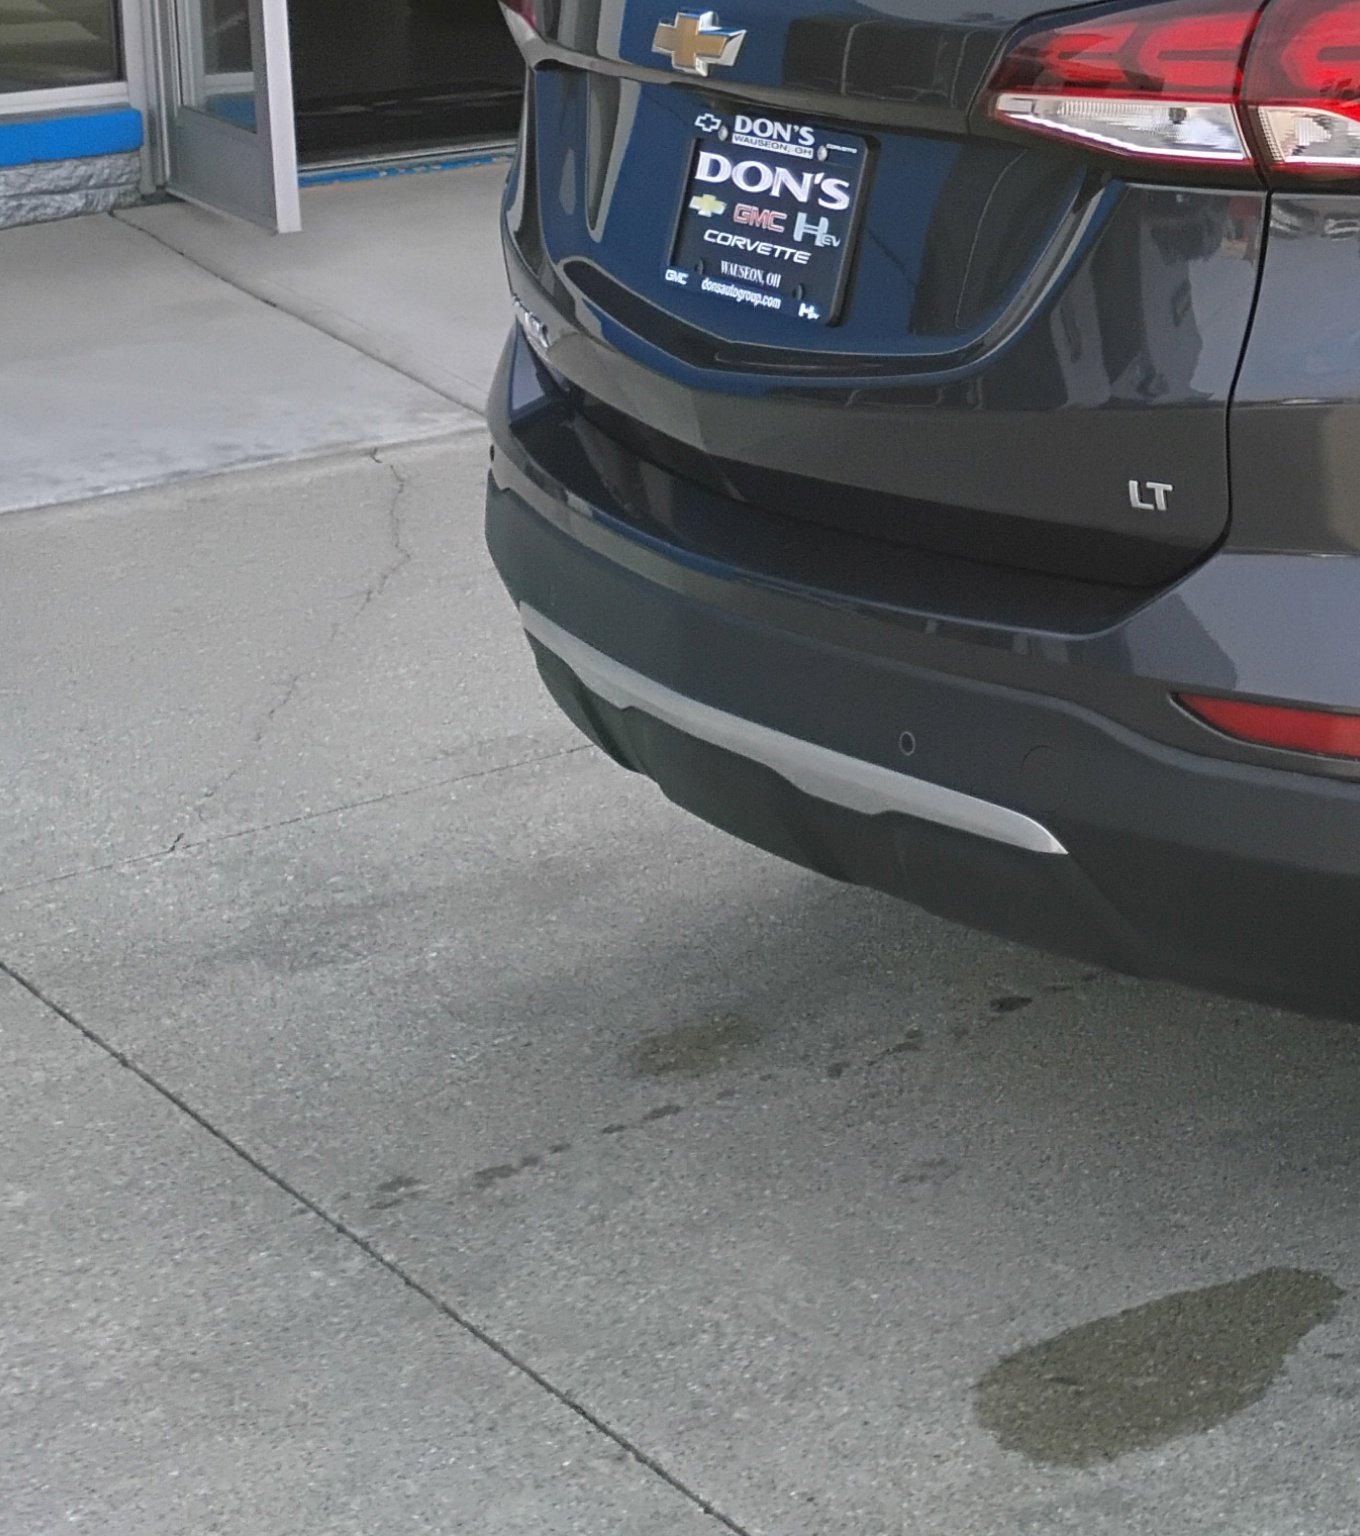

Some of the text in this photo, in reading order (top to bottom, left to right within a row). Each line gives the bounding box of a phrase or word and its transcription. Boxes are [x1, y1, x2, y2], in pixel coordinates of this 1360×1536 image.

[735, 115, 815, 145] DON'S
[794, 145, 813, 156] OH
[695, 151, 850, 211] DON'S
[733, 203, 788, 233] GMC
[703, 229, 813, 265] CORVETTE
[665, 269, 690, 285] GMC
[701, 277, 782, 310] donsautogroup.com
[1129, 480, 1173, 511] LT
